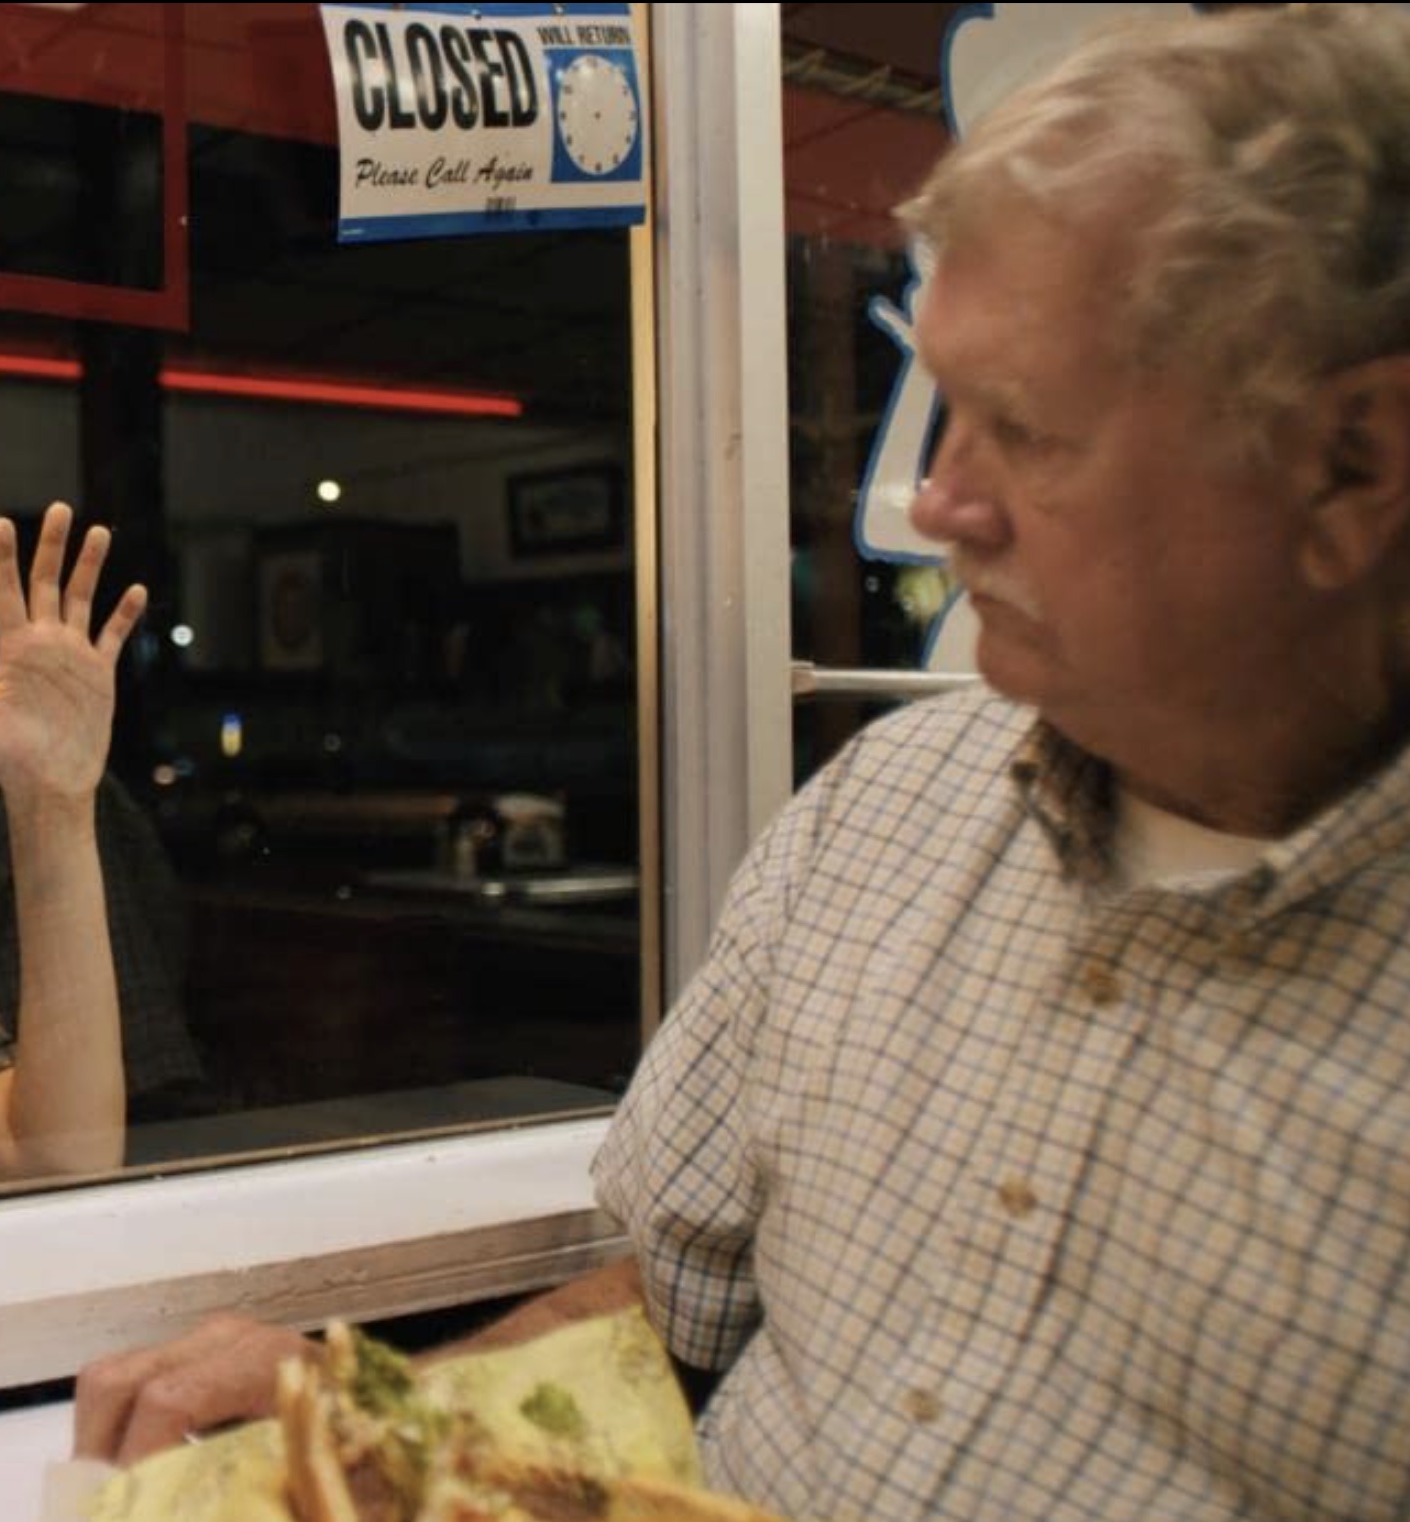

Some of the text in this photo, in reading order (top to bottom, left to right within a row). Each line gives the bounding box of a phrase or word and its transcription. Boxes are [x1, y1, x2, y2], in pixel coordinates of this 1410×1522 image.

[537, 25, 630, 45] WILL RETURN
[344, 20, 538, 131] CLOSED
[355, 156, 533, 190] Please Call Again
